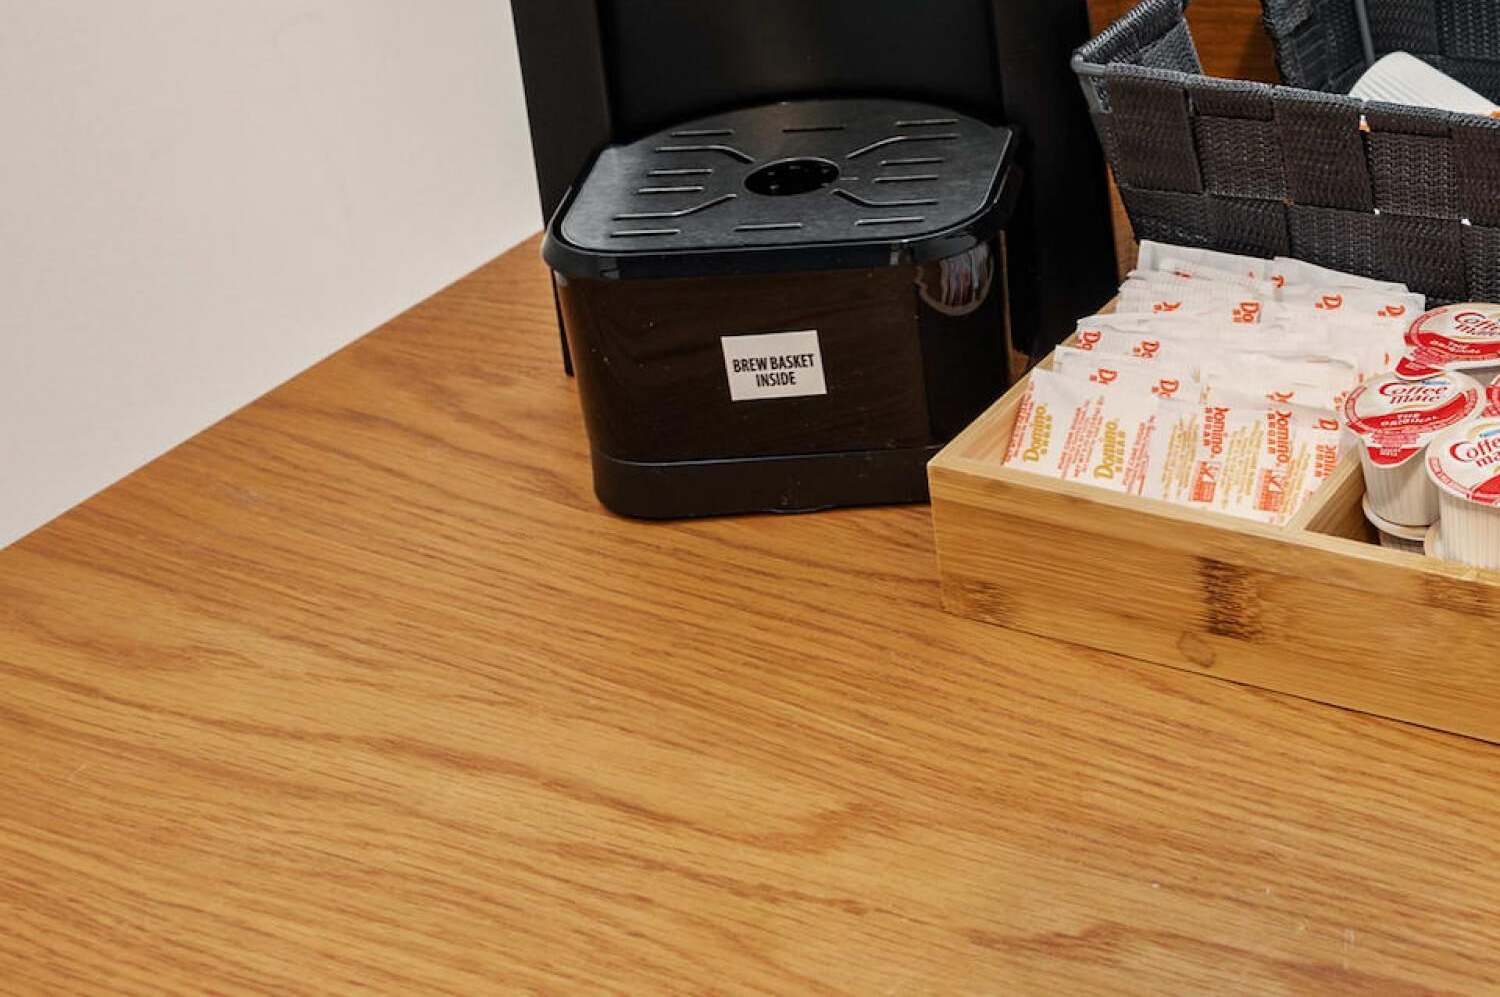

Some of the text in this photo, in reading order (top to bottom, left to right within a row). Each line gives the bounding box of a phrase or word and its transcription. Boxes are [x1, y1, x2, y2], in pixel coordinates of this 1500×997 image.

[732, 353, 816, 373] BREW BASKET
[755, 372, 798, 388] INSIDE
[1378, 382, 1448, 396] Coffee
[1390, 395, 1440, 404] mate
[1023, 406, 1046, 462] Domino
[1040, 414, 1053, 455] SUGAR
[1093, 421, 1118, 480] Domino
[1114, 430, 1126, 473] SUGAR
[1211, 407, 1231, 455] omino
[1266, 413, 1276, 455] SUGAR
